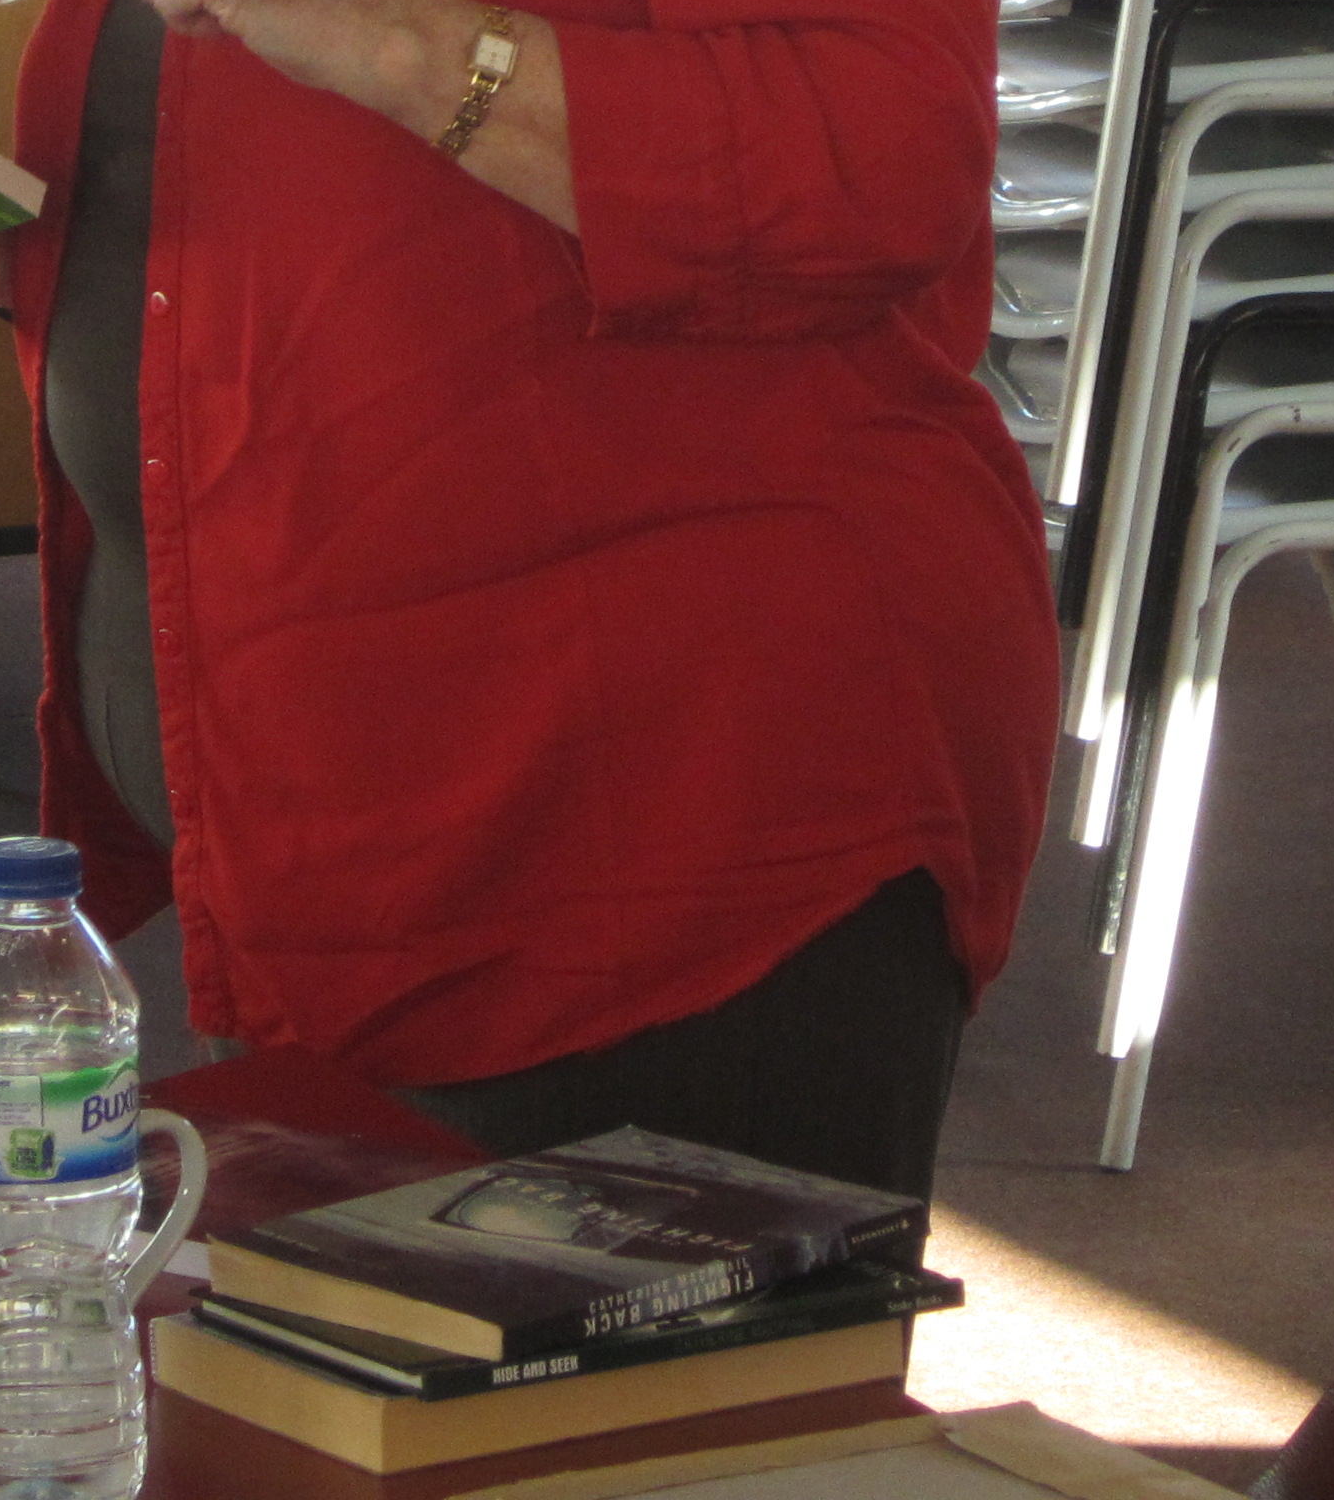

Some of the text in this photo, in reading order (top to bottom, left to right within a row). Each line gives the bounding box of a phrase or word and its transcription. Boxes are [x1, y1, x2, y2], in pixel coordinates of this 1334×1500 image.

[652, 1269, 755, 1316] FIGHTING
[583, 1306, 642, 1338] BACK
[522, 1361, 547, 1379] AND
